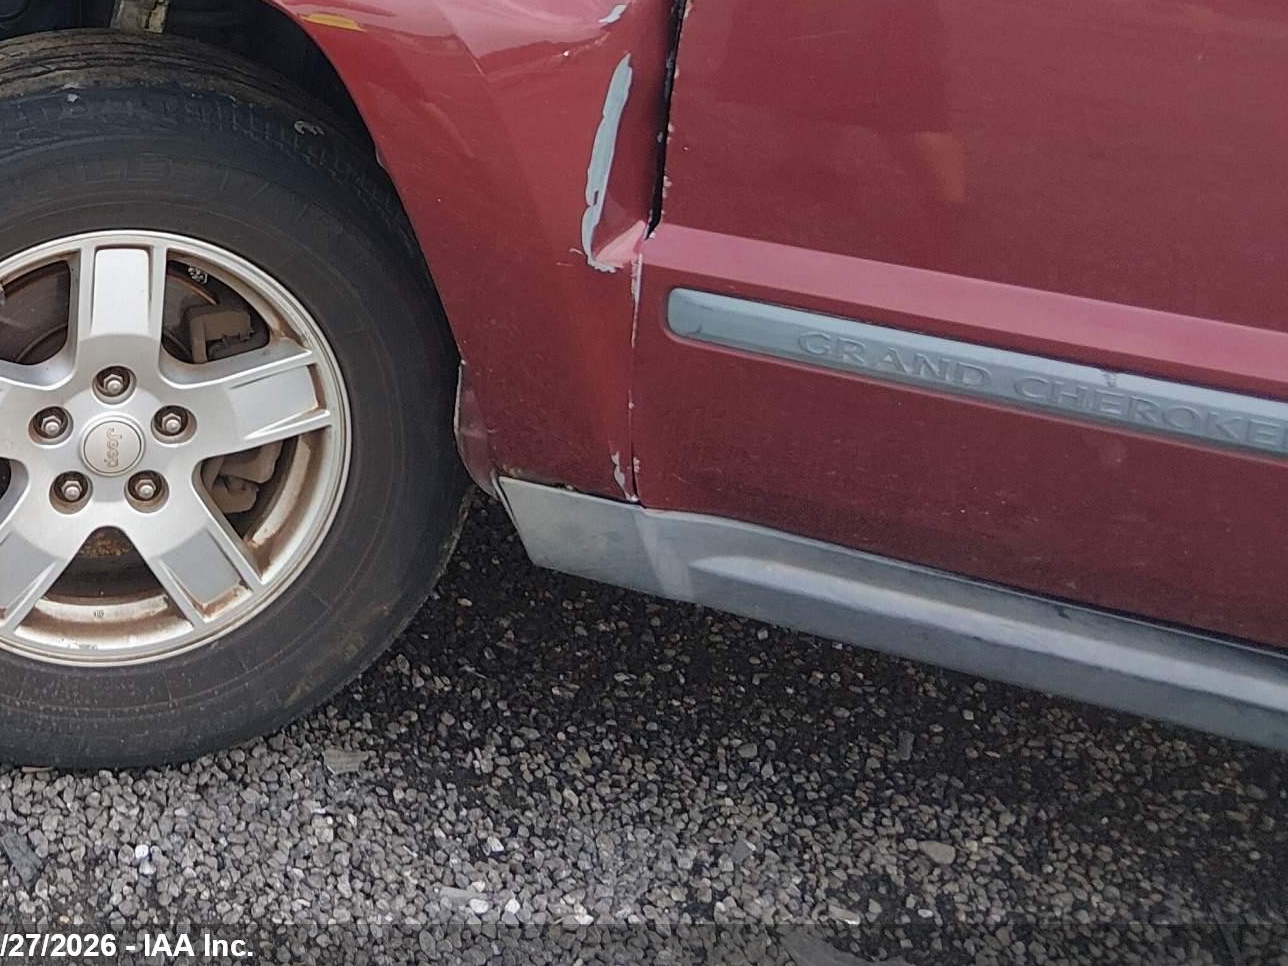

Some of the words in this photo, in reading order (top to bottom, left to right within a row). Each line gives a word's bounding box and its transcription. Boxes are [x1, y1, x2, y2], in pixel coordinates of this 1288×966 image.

[797, 330, 993, 387] GRAND
[1013, 375, 1288, 450] CHEROKE
[103, 427, 123, 468] Jeep
